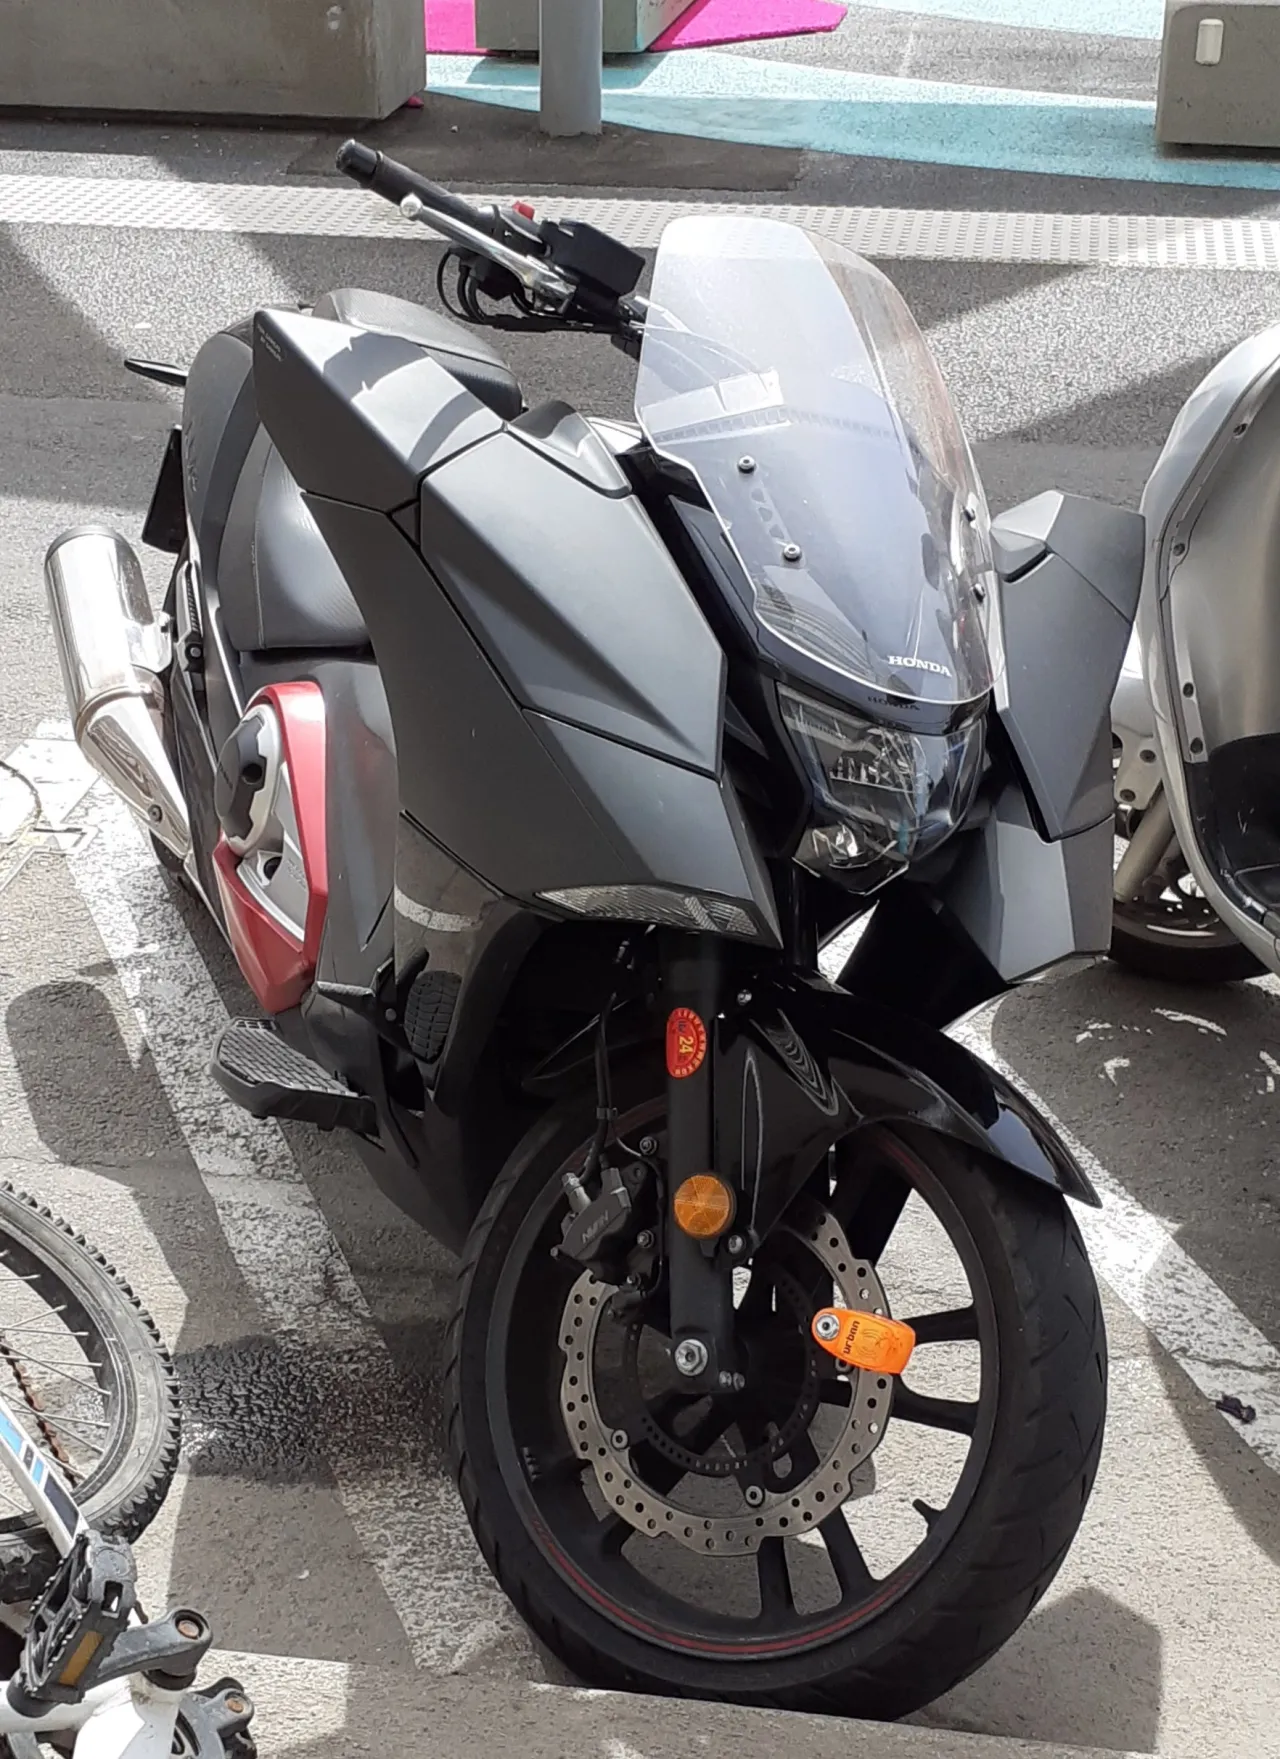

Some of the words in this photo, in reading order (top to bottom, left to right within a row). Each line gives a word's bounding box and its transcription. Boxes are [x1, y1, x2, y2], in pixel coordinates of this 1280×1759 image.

[887, 656, 952, 677] HONDA
[679, 1036, 694, 1054] 24
[843, 1320, 860, 1354] urban
